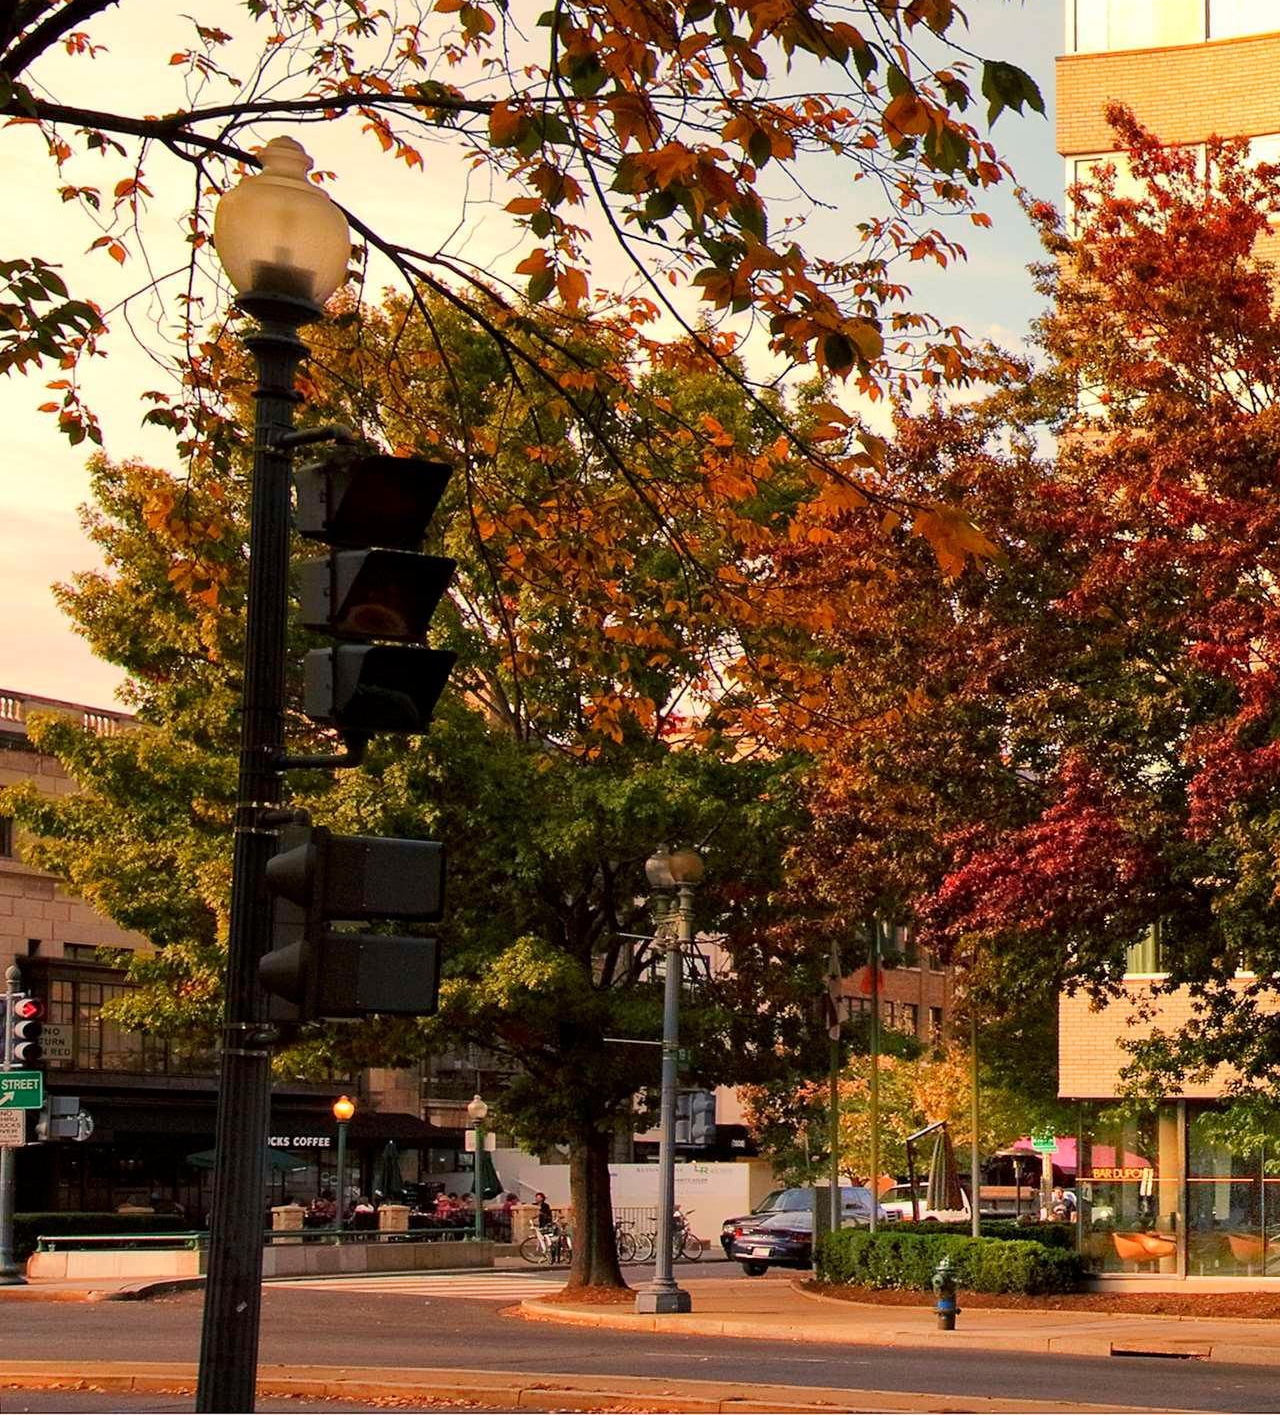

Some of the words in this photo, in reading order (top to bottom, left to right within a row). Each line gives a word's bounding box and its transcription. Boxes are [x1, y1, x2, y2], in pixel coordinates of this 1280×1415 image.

[1, 1079, 40, 1090] STREET
[292, 1136, 331, 1147] COFFEE
[1093, 1168, 1113, 1179] BAR
